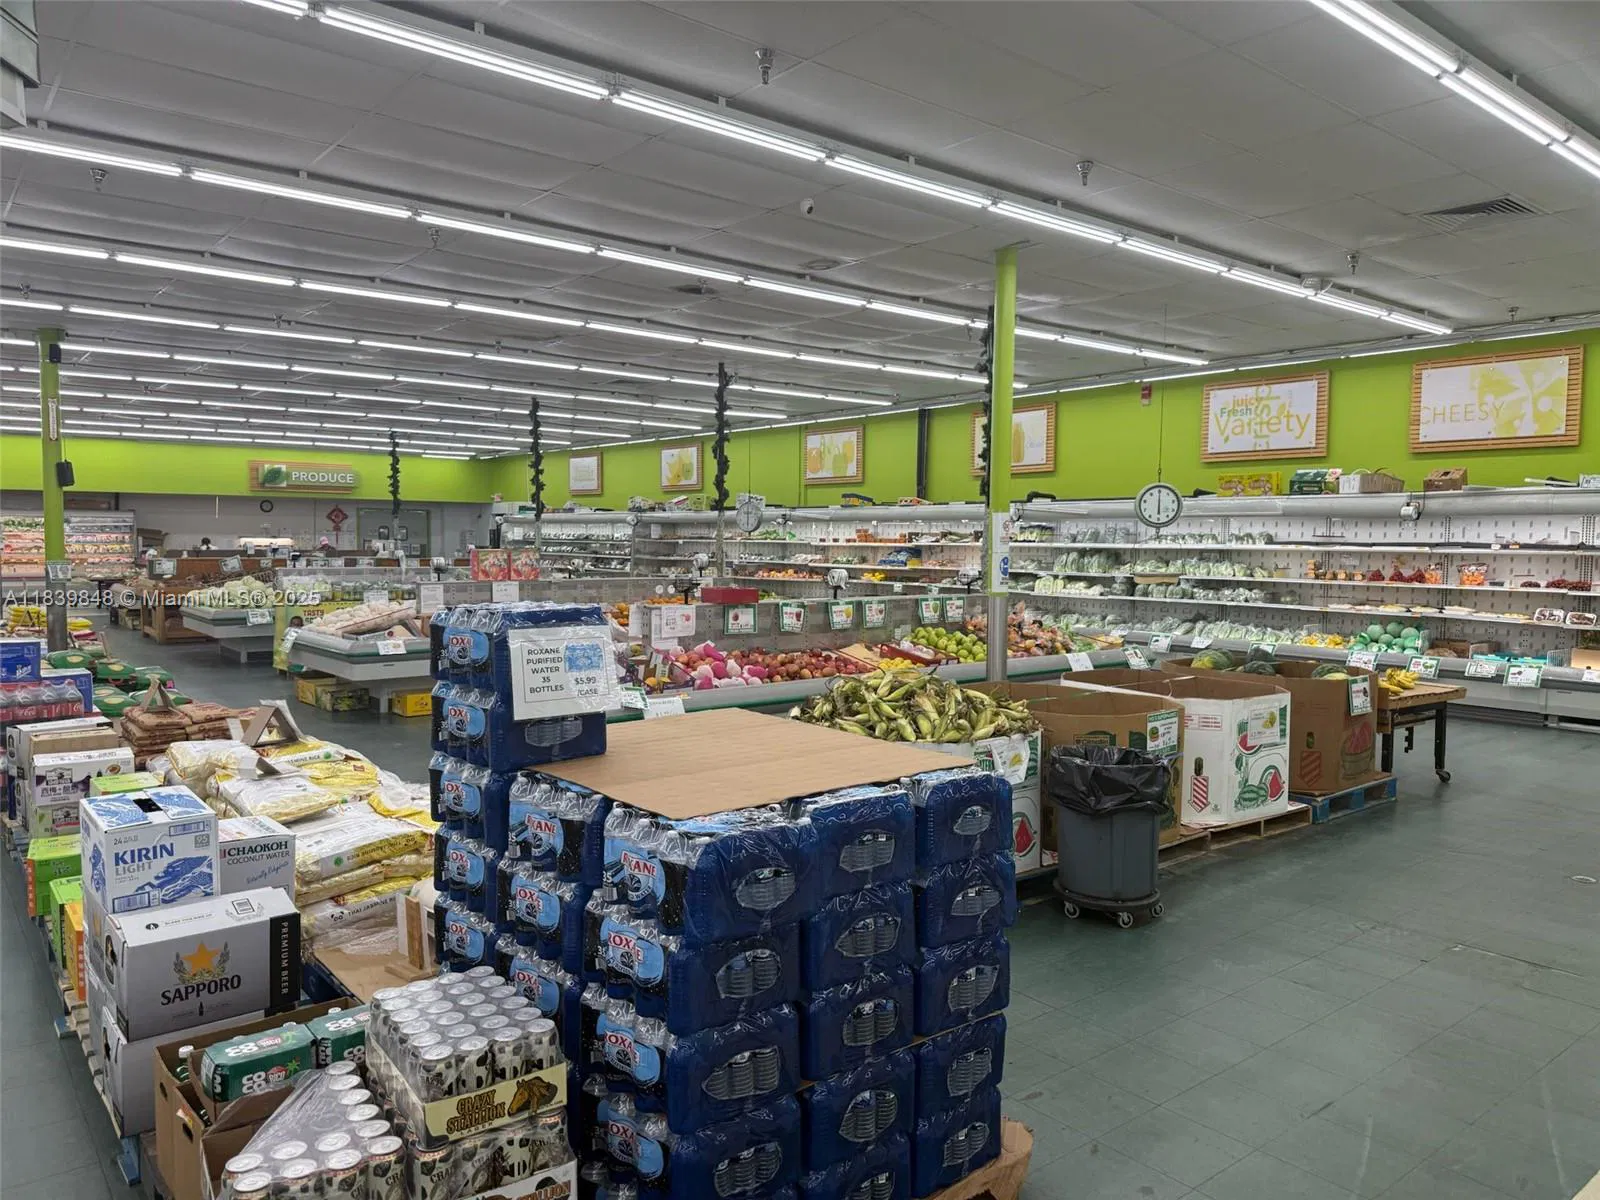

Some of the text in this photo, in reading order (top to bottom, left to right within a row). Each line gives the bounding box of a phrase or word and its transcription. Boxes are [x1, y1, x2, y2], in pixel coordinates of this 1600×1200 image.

[1220, 406, 1252, 418] Fresh
[1421, 402, 1504, 425] CHEESY
[1215, 408, 1312, 440] Variety
[291, 471, 355, 484] PRODUCE
[527, 647, 561, 656] ROXANE
[526, 657, 563, 666] PURIFIED
[531, 666, 560, 675] WATER
[574, 676, 597, 686] $5.99
[529, 685, 565, 694] BOTTLES
[576, 687, 599, 697] /CASE
[114, 842, 175, 866] KIRIN
[227, 841, 288, 857] CHAOKOH
[227, 850, 290, 866] COCONUT WATER
[115, 861, 153, 877] LIGHT
[602, 871, 613, 883] 35
[280, 921, 290, 995] PREMIUM BEER
[160, 974, 242, 1006] SAPPORO
[242, 1071, 266, 1084] CO
[456, 1089, 497, 1116] CRAZY
[446, 1101, 506, 1135] STALLION
[459, 1122, 494, 1136] LAGER
[430, 1168, 451, 1184] CRA
